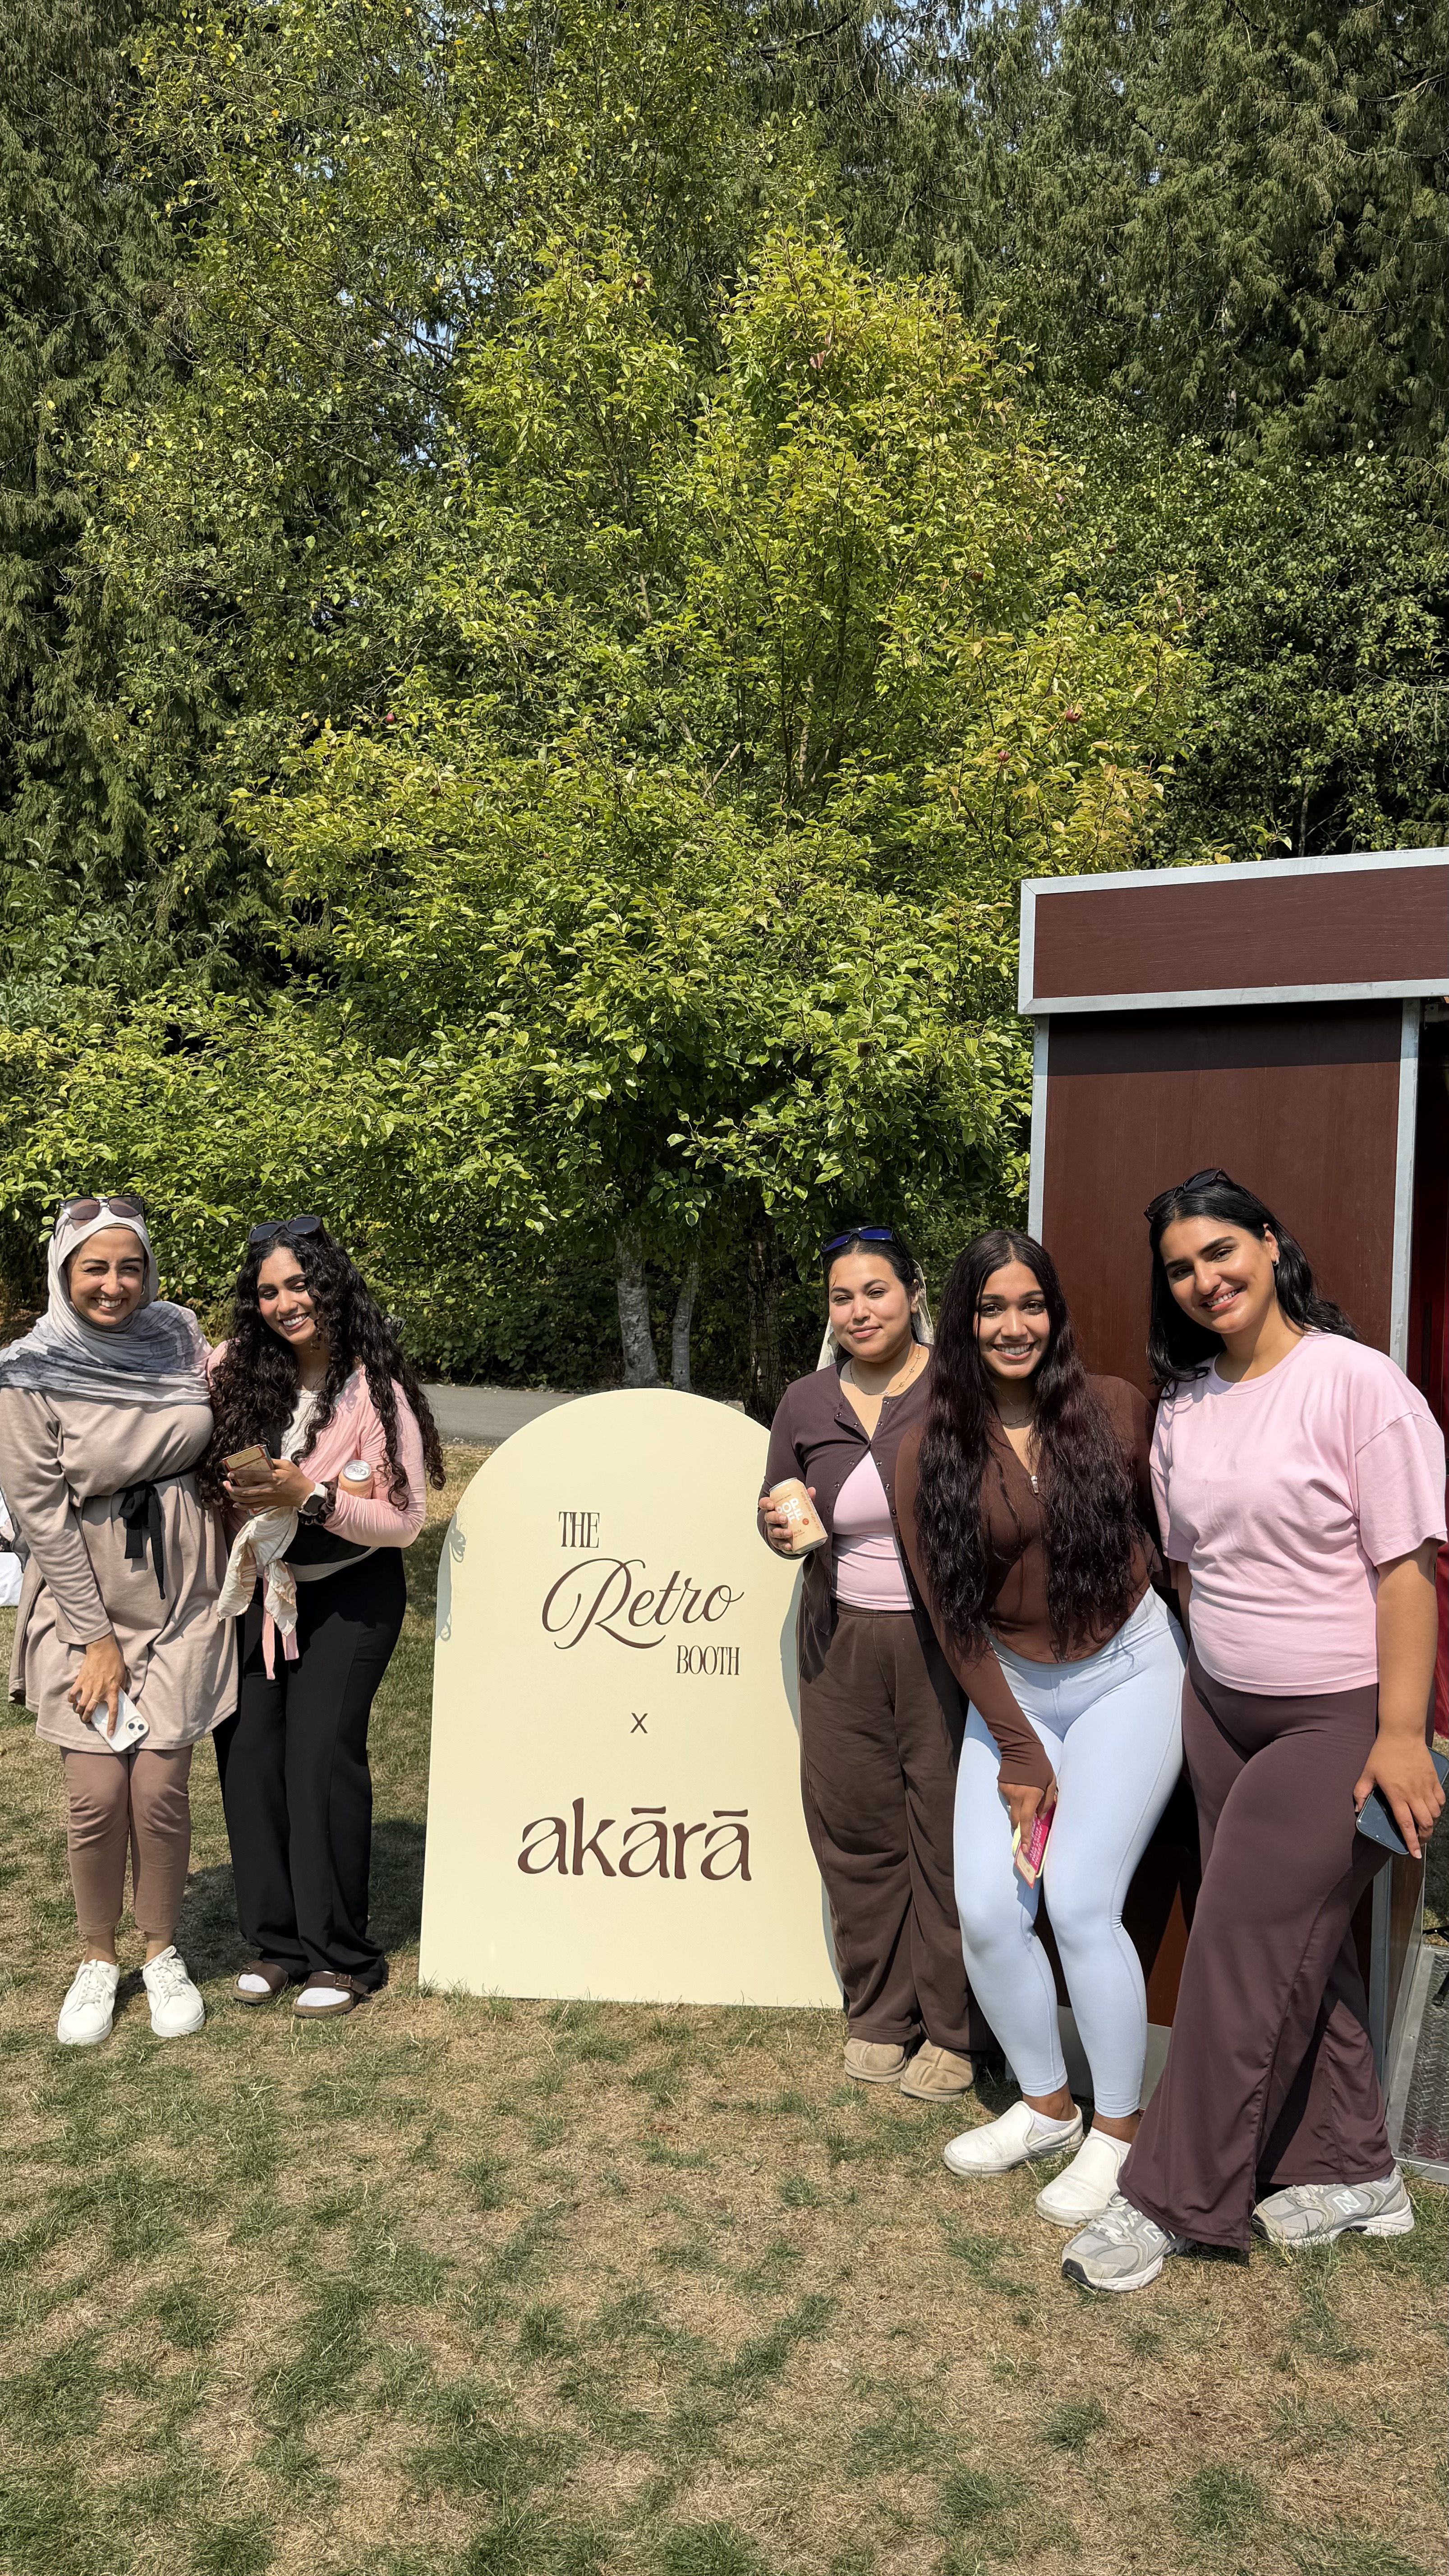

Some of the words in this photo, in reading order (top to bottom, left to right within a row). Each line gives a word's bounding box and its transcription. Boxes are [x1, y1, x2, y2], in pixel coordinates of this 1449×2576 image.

[558, 1511, 600, 1548] THE
[542, 1558, 745, 1649] Retro
[676, 1645, 741, 1676] BOOTH
[517, 1797, 752, 1881] akārā
